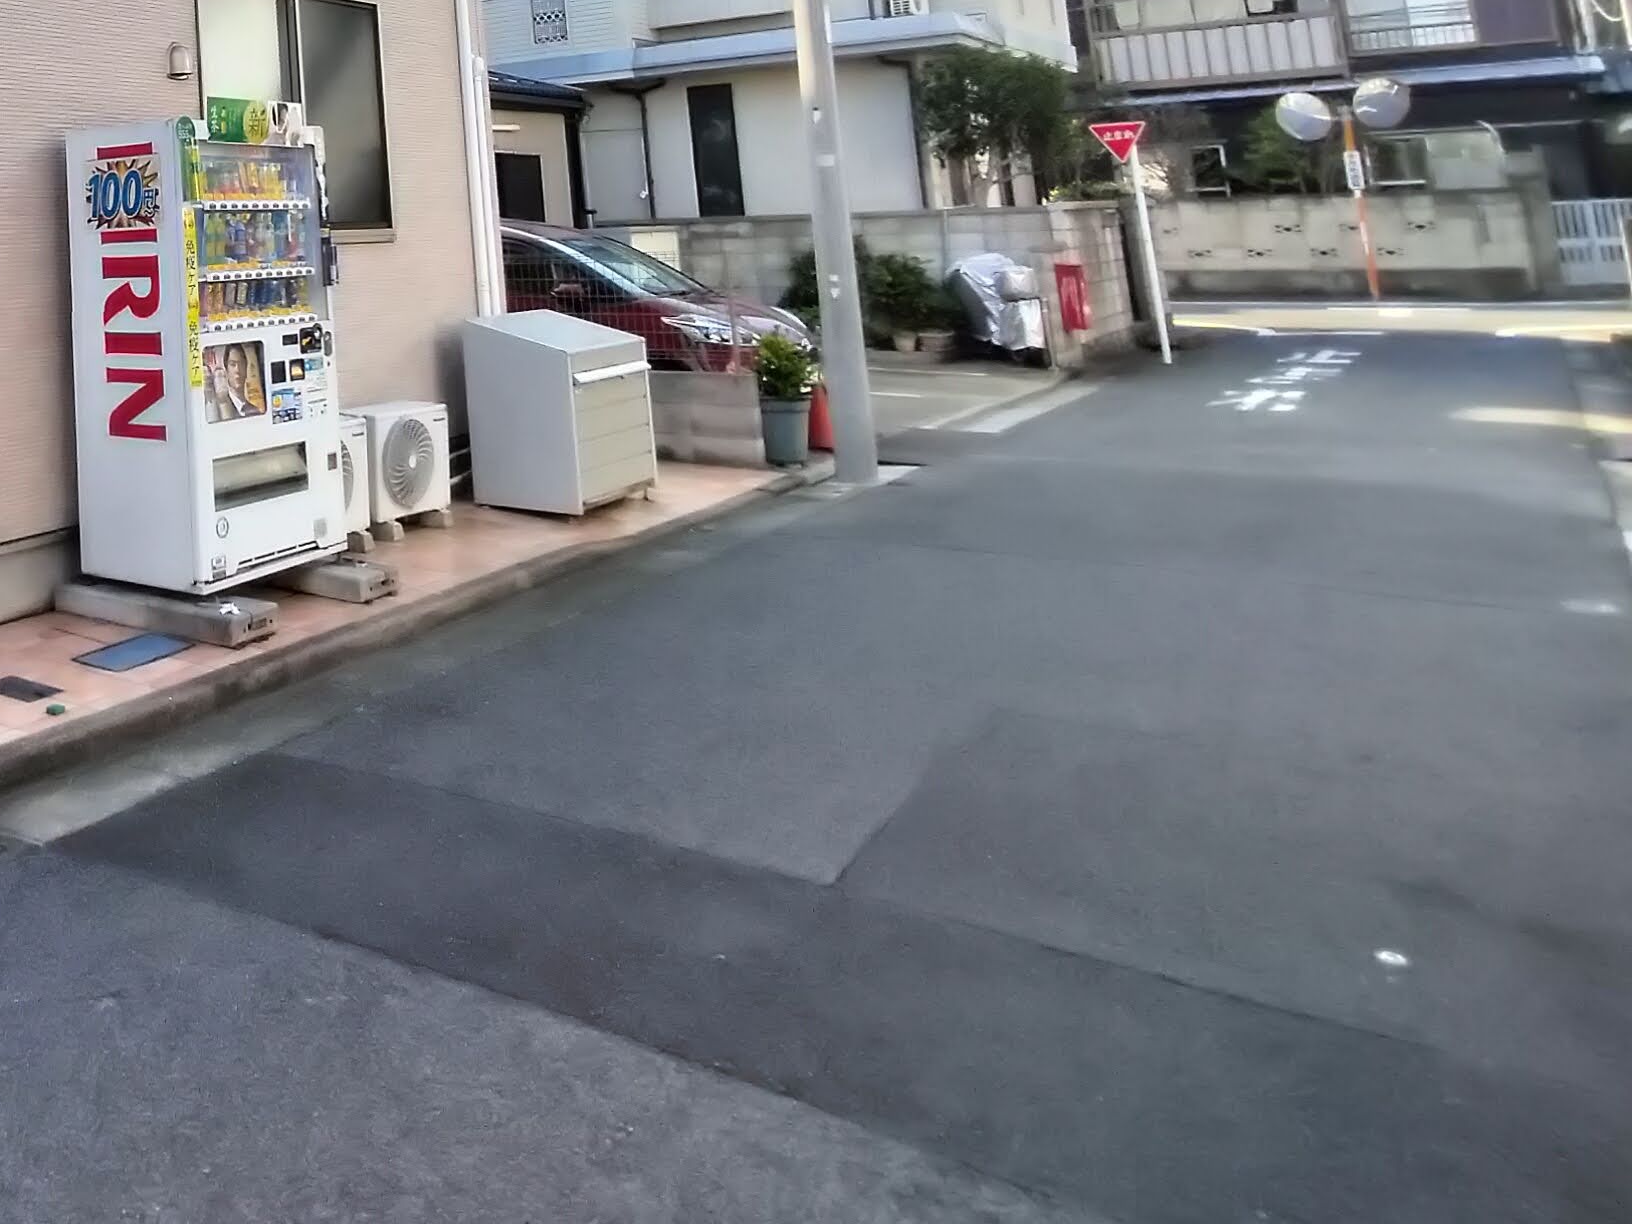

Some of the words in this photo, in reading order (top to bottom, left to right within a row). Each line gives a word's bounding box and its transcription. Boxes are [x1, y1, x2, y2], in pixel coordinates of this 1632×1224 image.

[248, 106, 267, 139] 新
[1103, 129, 1136, 142] 止まれ
[185, 239, 197, 296] 免疫ケア
[189, 321, 201, 377] 免疫ケア
